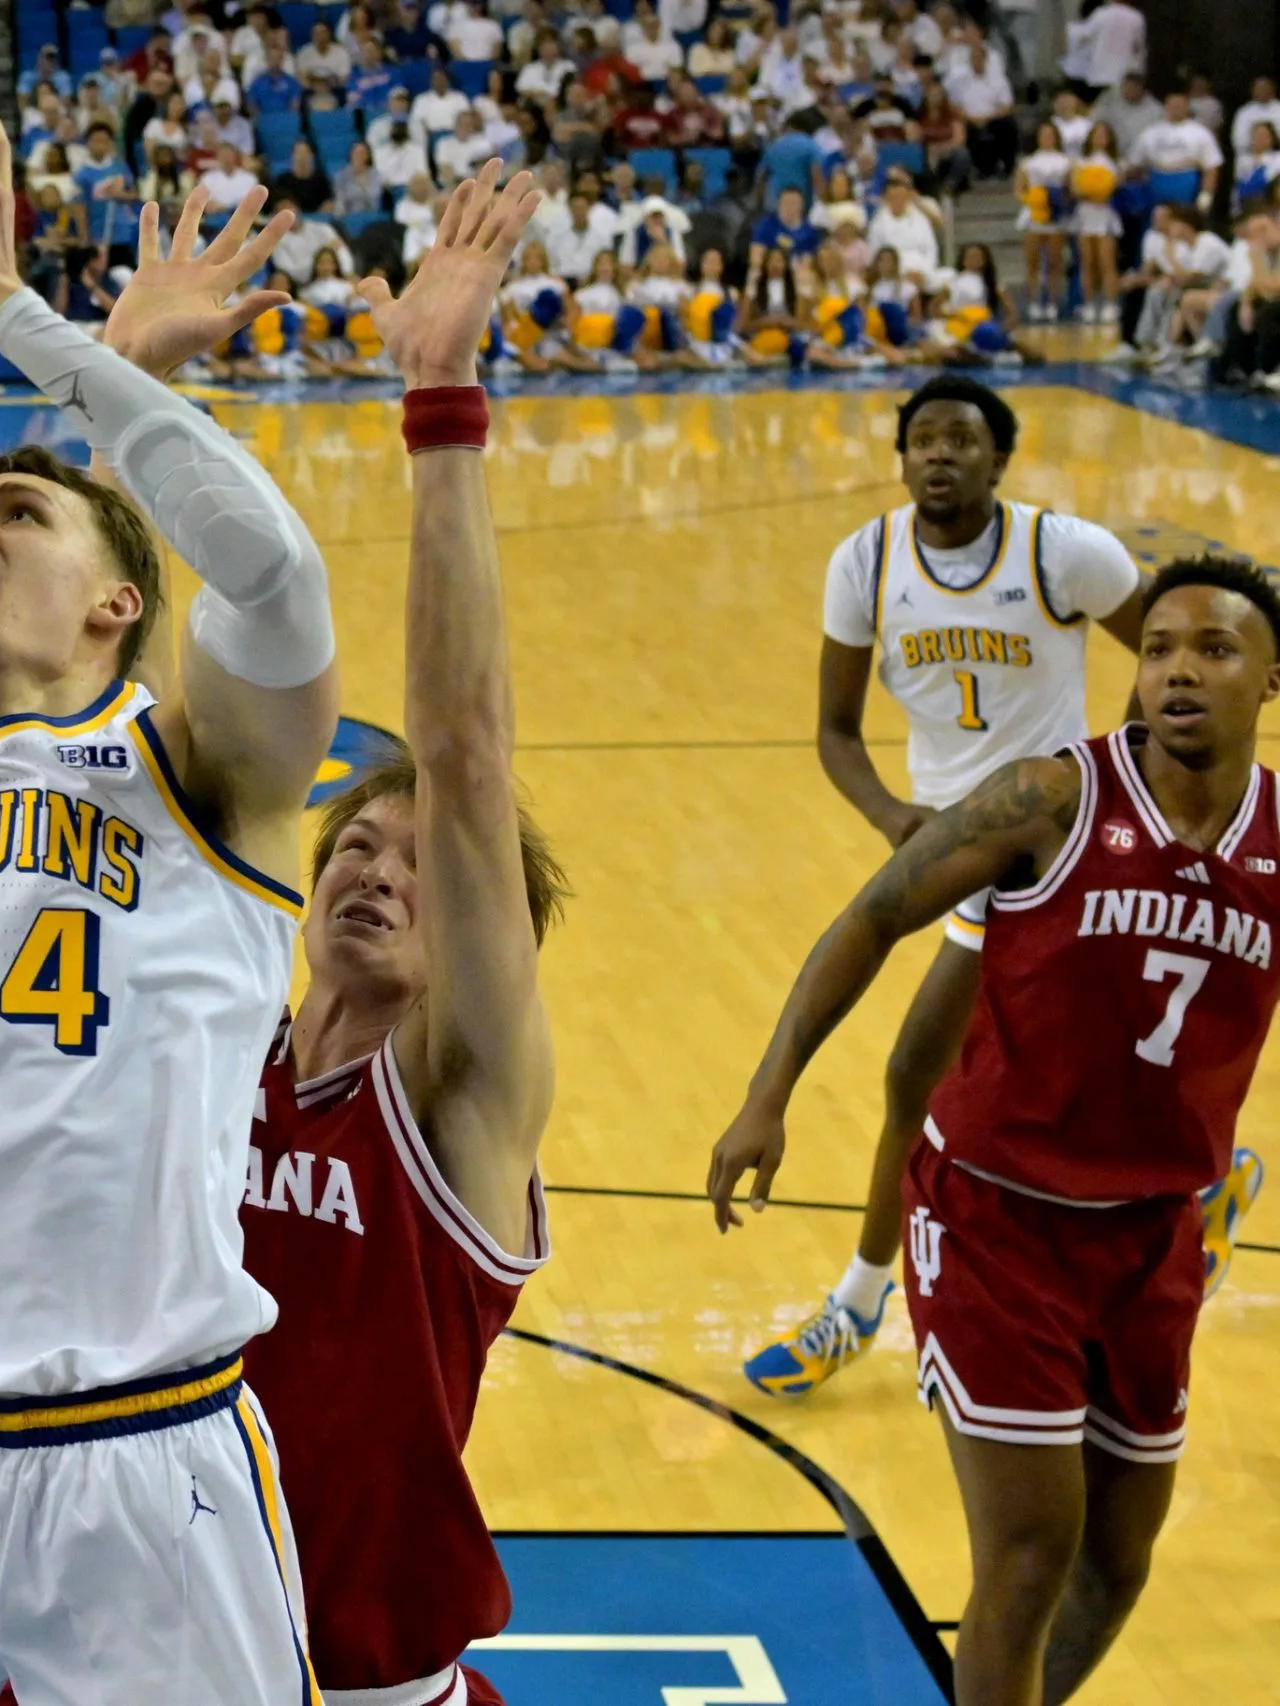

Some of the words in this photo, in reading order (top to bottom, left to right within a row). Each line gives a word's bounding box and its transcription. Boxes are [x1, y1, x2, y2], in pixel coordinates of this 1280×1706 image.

[899, 626, 1033, 669] BRUINS
[953, 670, 988, 731] 1
[1077, 888, 1272, 971] INDIANA
[1134, 947, 1212, 1068] 7
